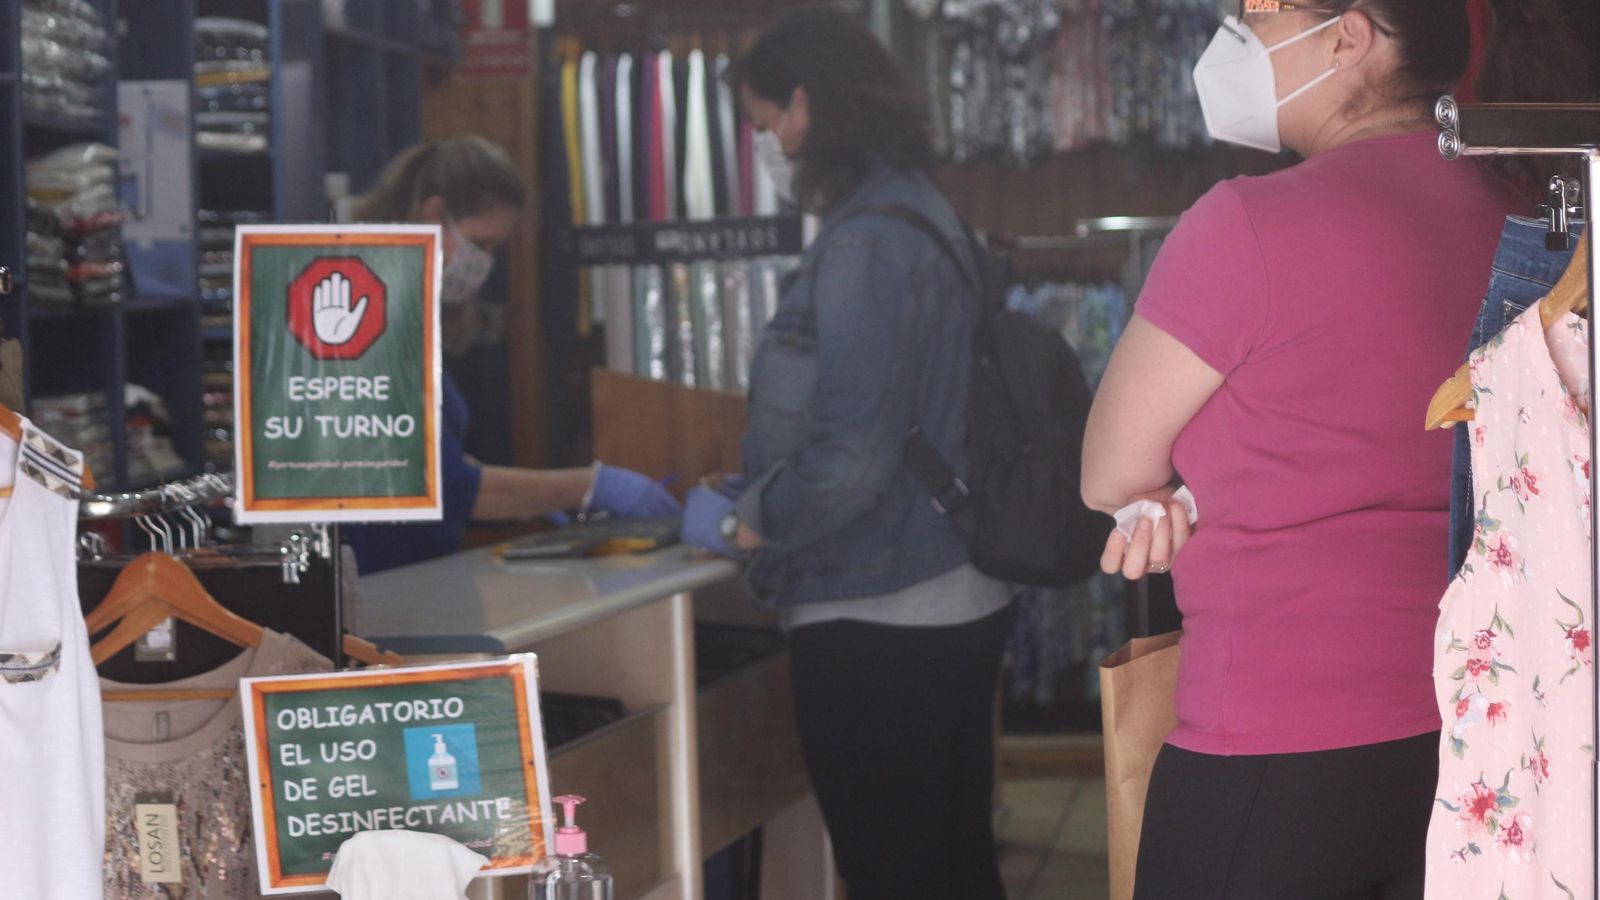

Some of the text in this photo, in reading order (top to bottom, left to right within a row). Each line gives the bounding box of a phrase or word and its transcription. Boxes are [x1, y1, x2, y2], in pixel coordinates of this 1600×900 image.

[288, 375, 391, 402] ESPERE
[264, 413, 415, 439] SU TURNO
[276, 697, 465, 731] OBLIGATORIO
[279, 739, 377, 767] EL USO
[284, 774, 377, 802] DE GEL
[287, 796, 512, 838] DESINFECTANTE
[144, 812, 165, 874] LOSAN
